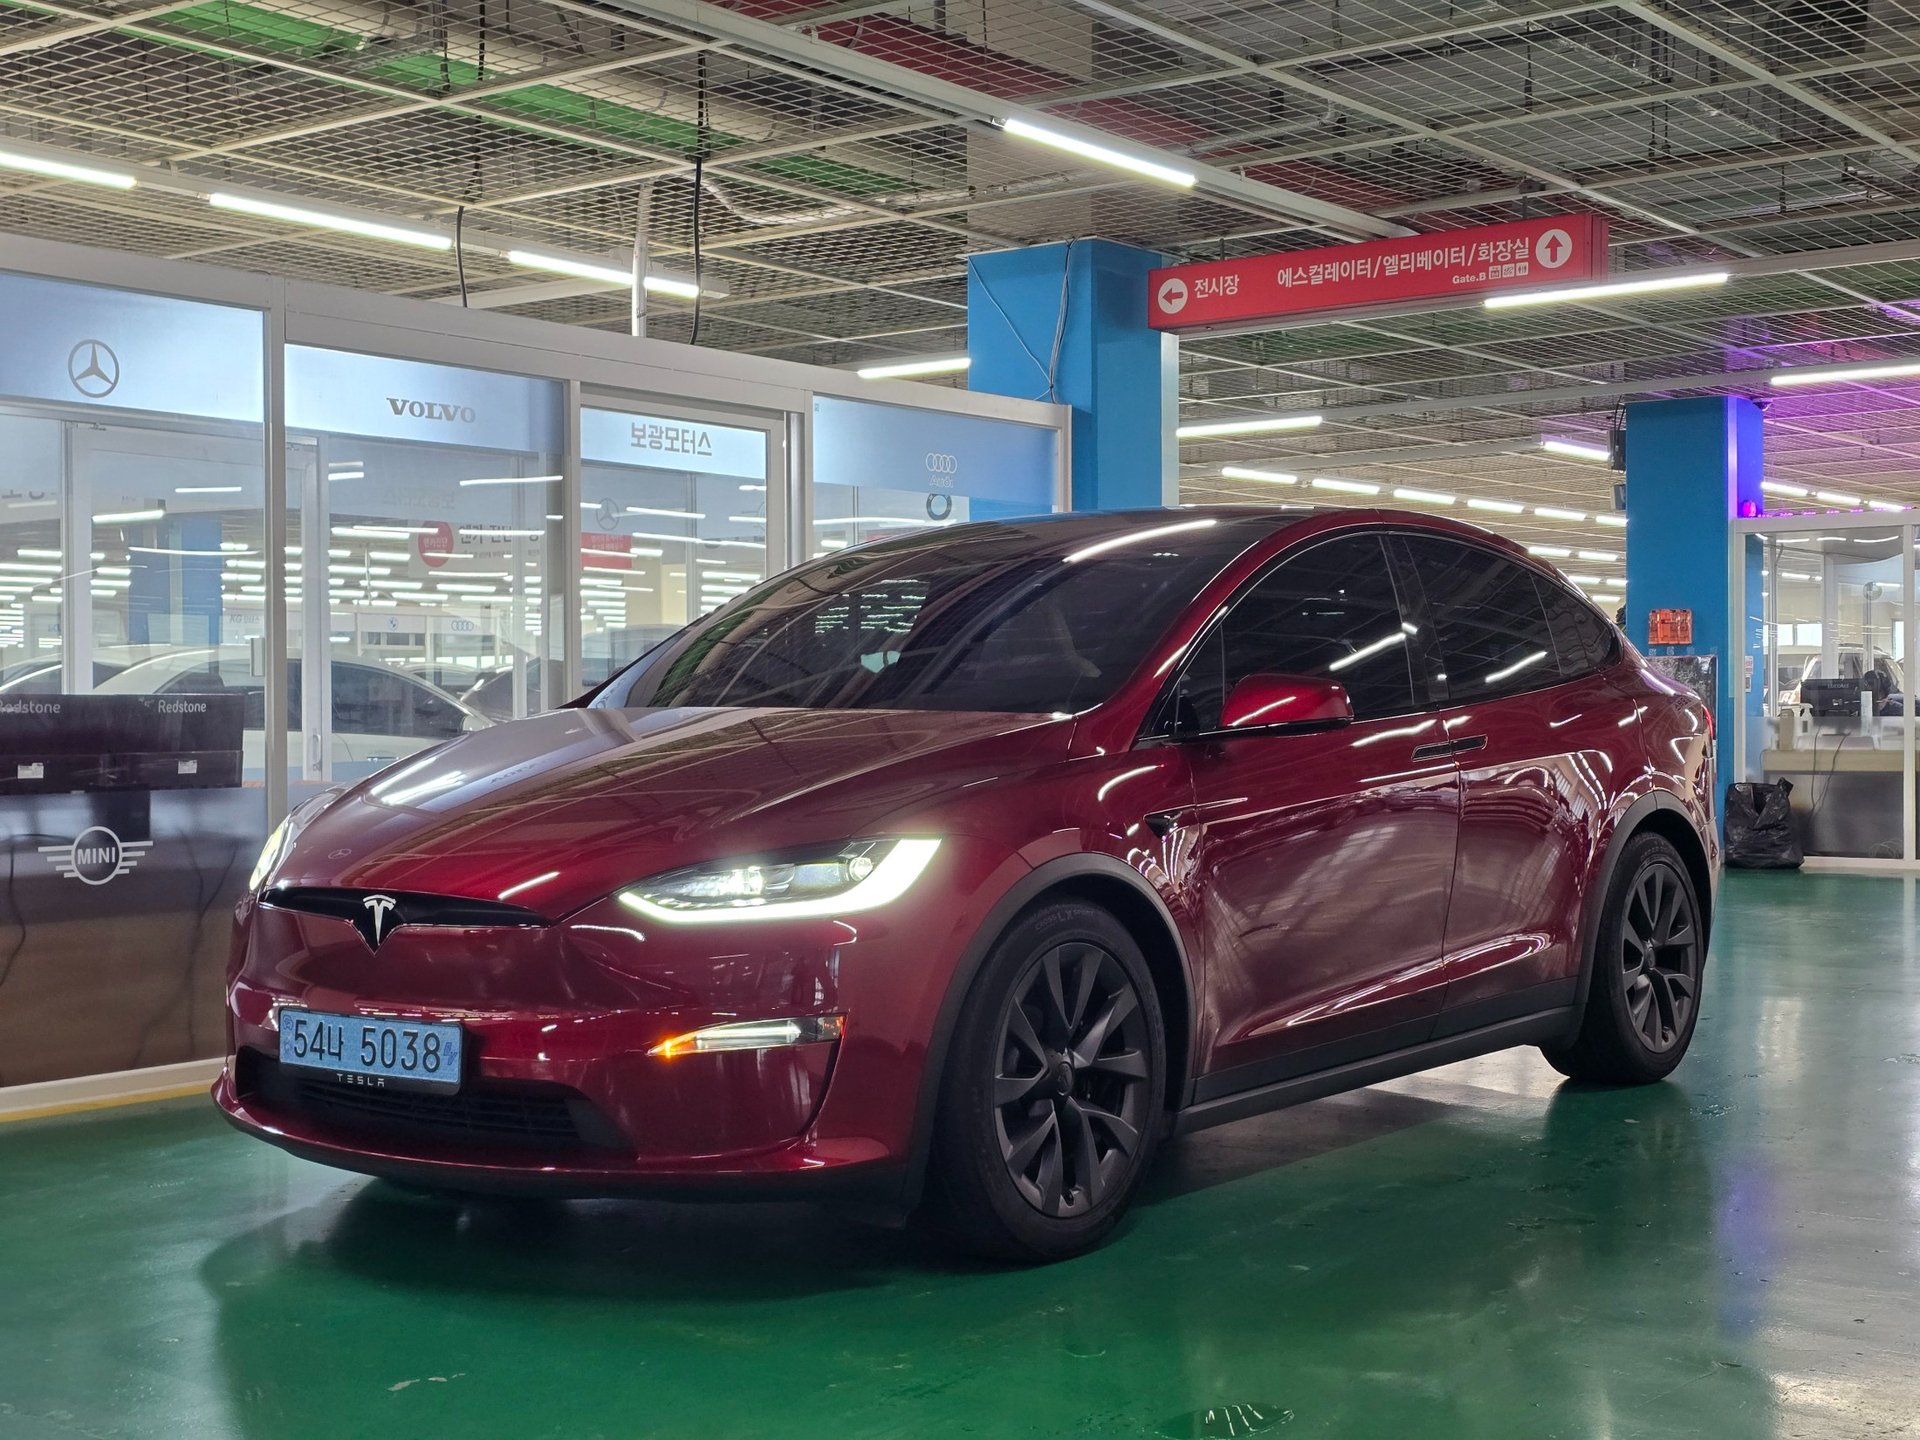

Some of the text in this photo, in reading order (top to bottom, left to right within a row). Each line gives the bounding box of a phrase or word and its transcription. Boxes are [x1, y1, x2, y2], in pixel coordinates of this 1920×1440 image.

[1277, 237, 1530, 288] 에스컬레이터/엘리베이터/화장실
[1194, 274, 1240, 299] 전시장
[1452, 271, 1487, 285] Gate.B
[386, 397, 476, 423] VOLVO
[630, 422, 712, 456] 보광모터스
[158, 699, 208, 714] Redstone
[77, 846, 116, 865] MINI
[294, 1018, 441, 1073] 54나 5038
[336, 1072, 385, 1088] TESLA
